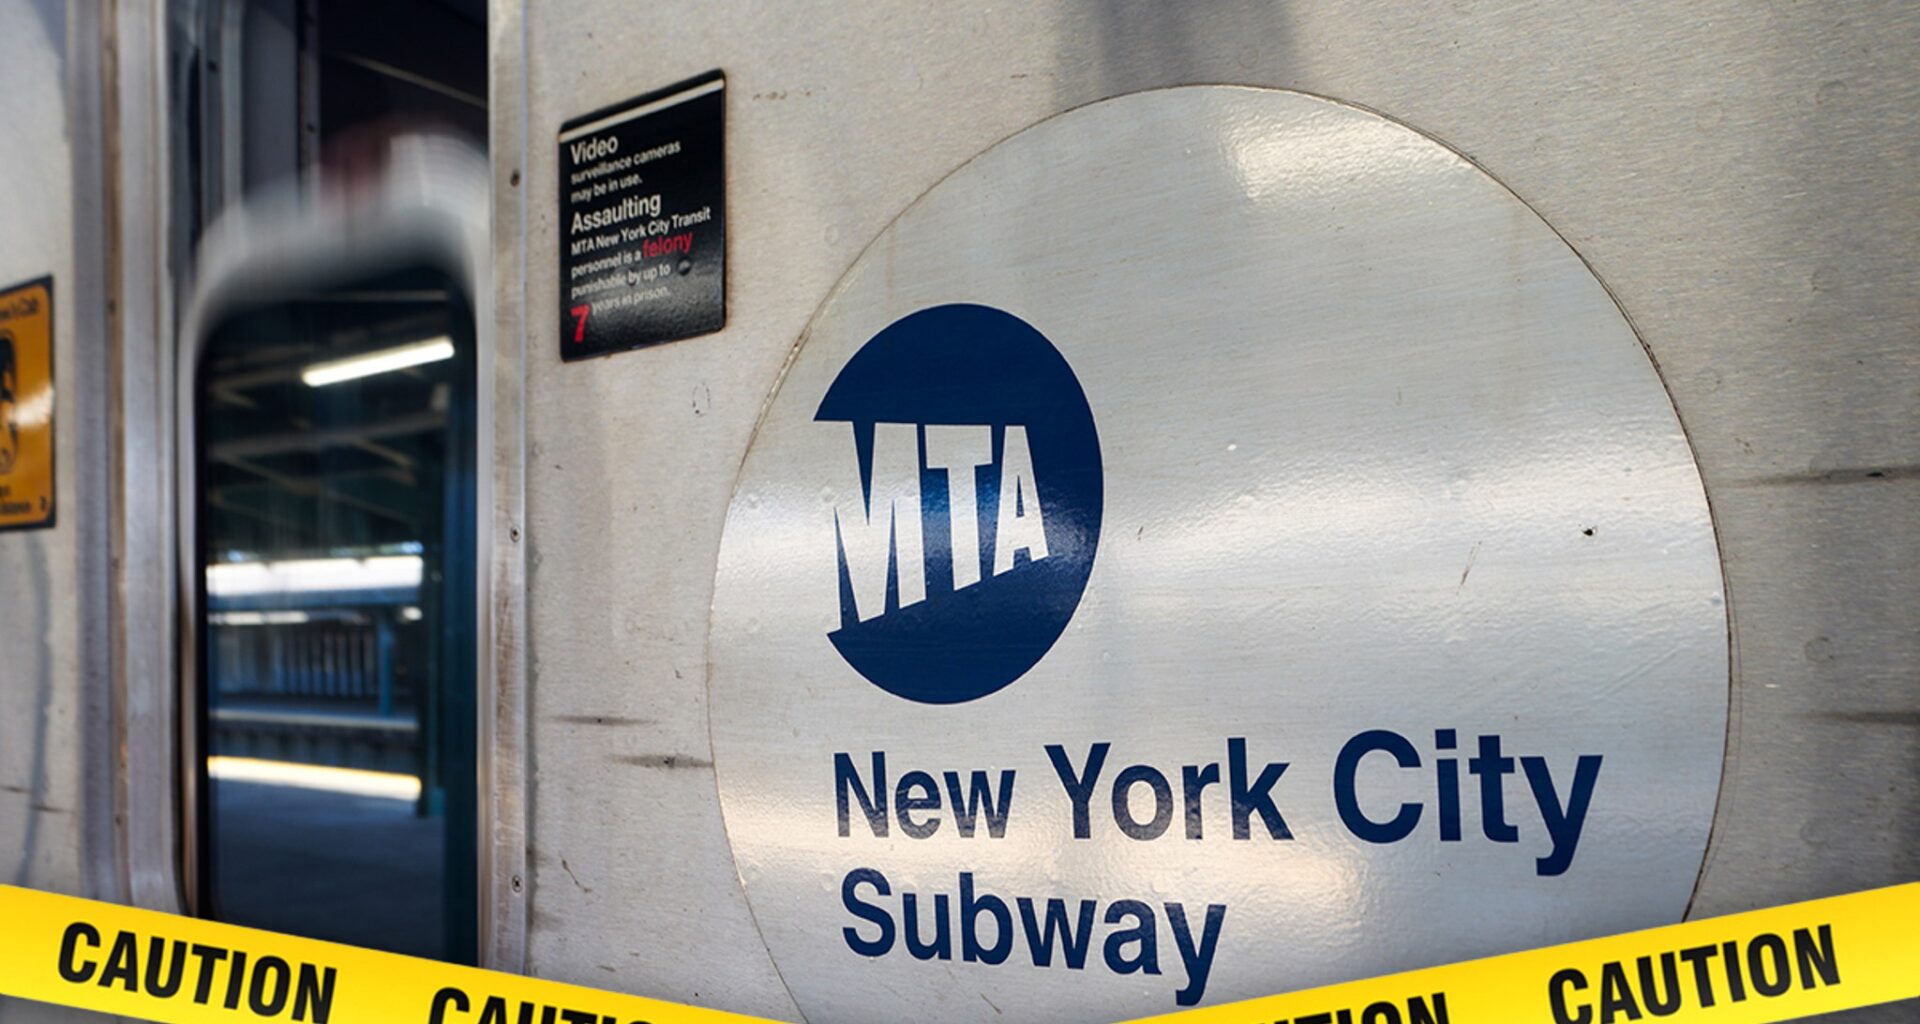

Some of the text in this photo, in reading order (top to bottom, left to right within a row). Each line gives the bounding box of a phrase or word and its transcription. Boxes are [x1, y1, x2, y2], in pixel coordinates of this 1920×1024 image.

[570, 141, 681, 185] surveillance cameras
[571, 136, 618, 165] Video
[571, 173, 643, 203] may be in use.
[571, 194, 661, 235] Assaulting
[571, 206, 711, 256] MTA New York City Transit
[571, 232, 693, 279] personnel is a felony
[571, 263, 671, 300] punishable by up to
[570, 286, 672, 343] 7 years in prison.
[815, 421, 1049, 628] MTA
[833, 728, 1604, 877] New York City
[841, 867, 1227, 1007] Subway
